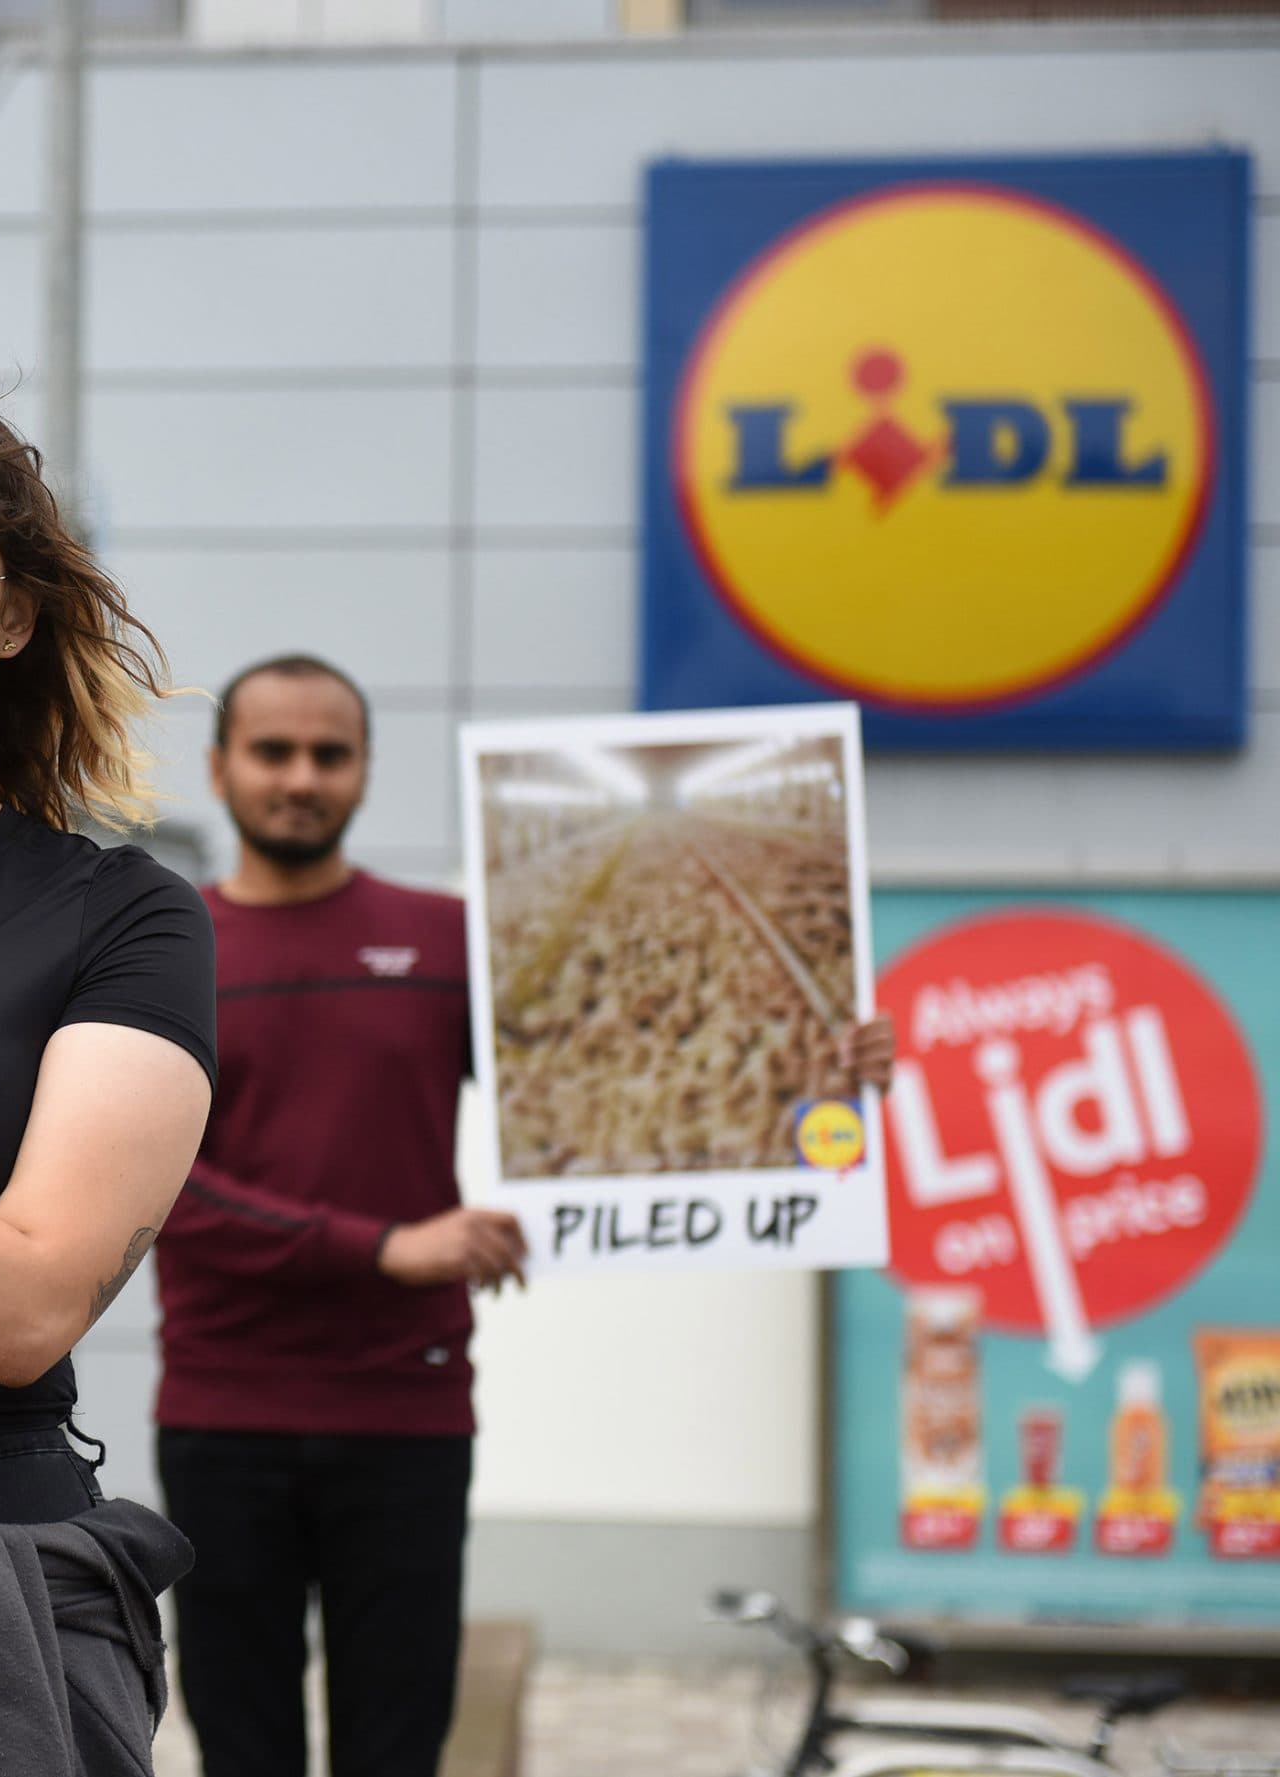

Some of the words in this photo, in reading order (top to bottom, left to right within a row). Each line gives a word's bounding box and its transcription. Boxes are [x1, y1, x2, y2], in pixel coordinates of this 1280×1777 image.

[912, 965, 1116, 1050] Always
[890, 1003, 1192, 1215] Lidl
[552, 1197, 722, 1256] PILED
[747, 1194, 818, 1247] UP
[934, 1212, 1017, 1275] on
[1064, 1172, 1207, 1261] price
